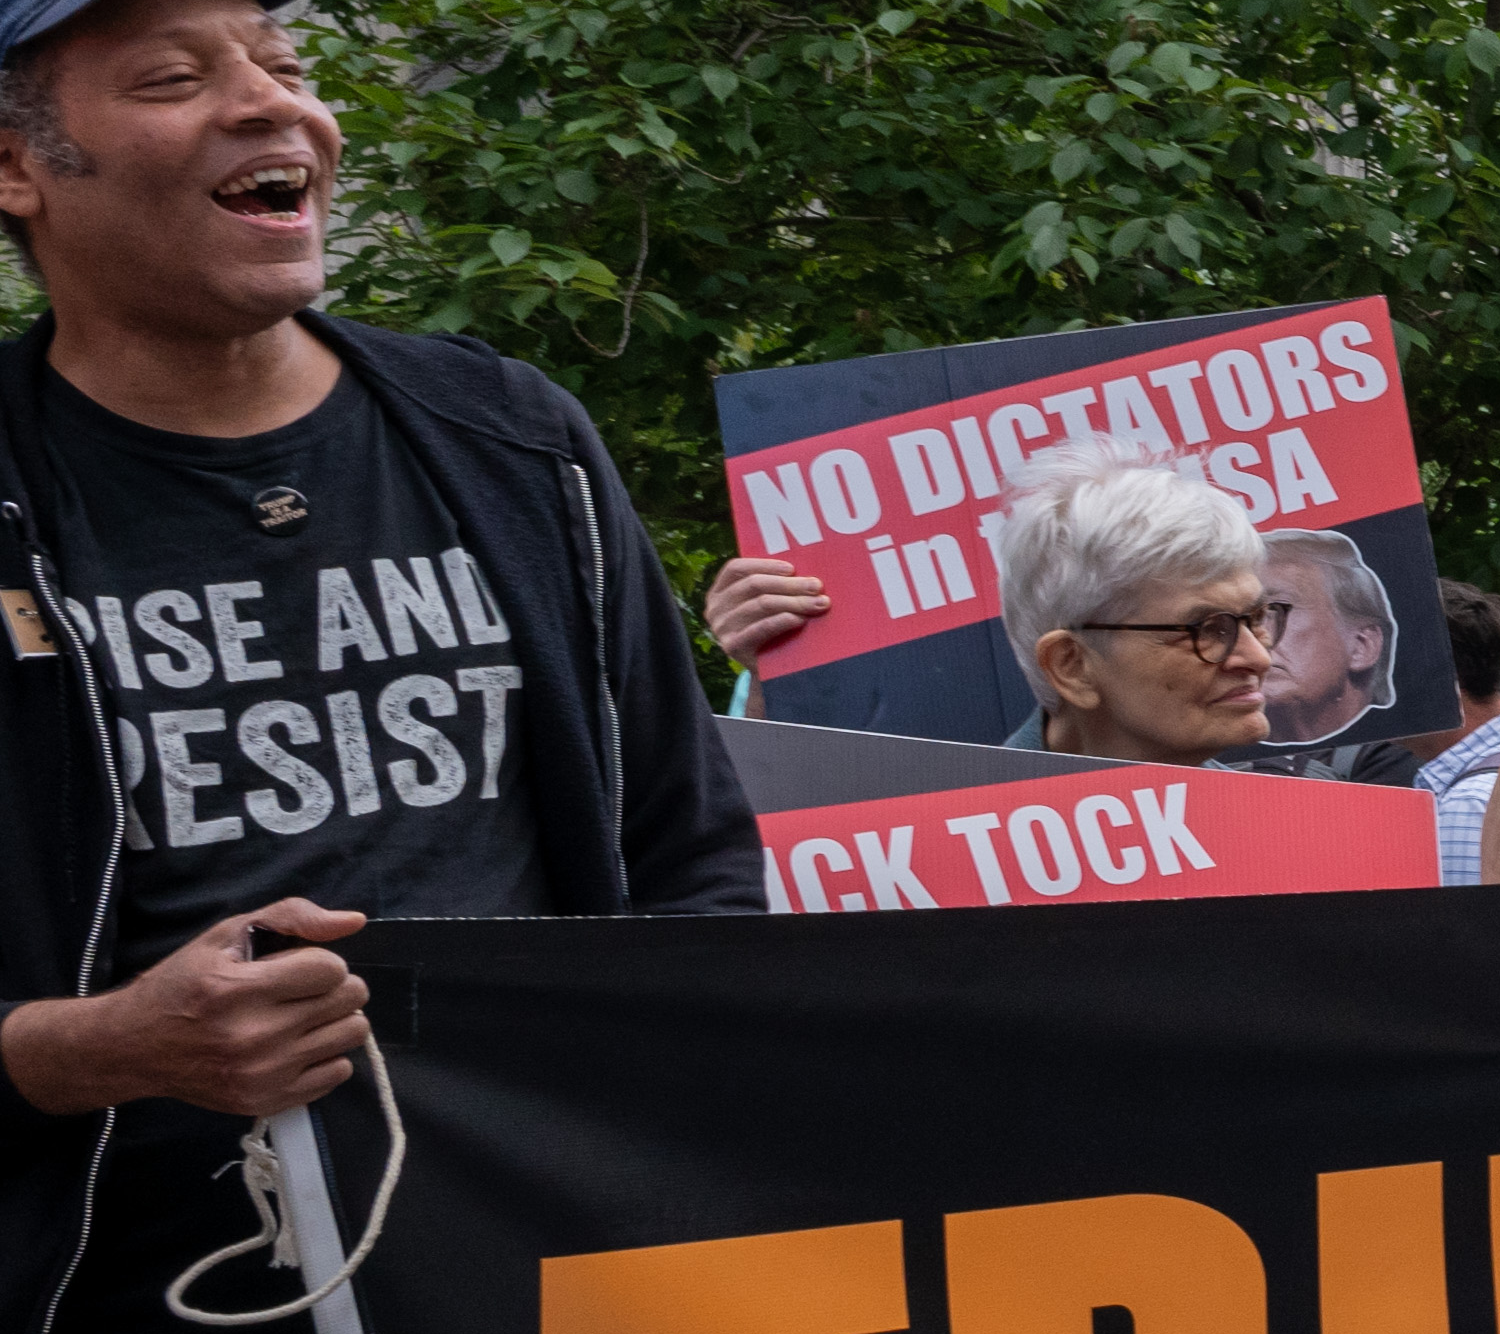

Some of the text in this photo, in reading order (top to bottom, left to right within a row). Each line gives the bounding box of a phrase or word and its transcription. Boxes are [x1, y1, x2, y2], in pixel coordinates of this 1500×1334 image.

[742, 319, 1391, 556] NO DICTATORS
[867, 532, 977, 620] in
[1180, 427, 1340, 528] SA
[316, 546, 512, 672] AND
[762, 782, 1218, 915] ICK TOCK
